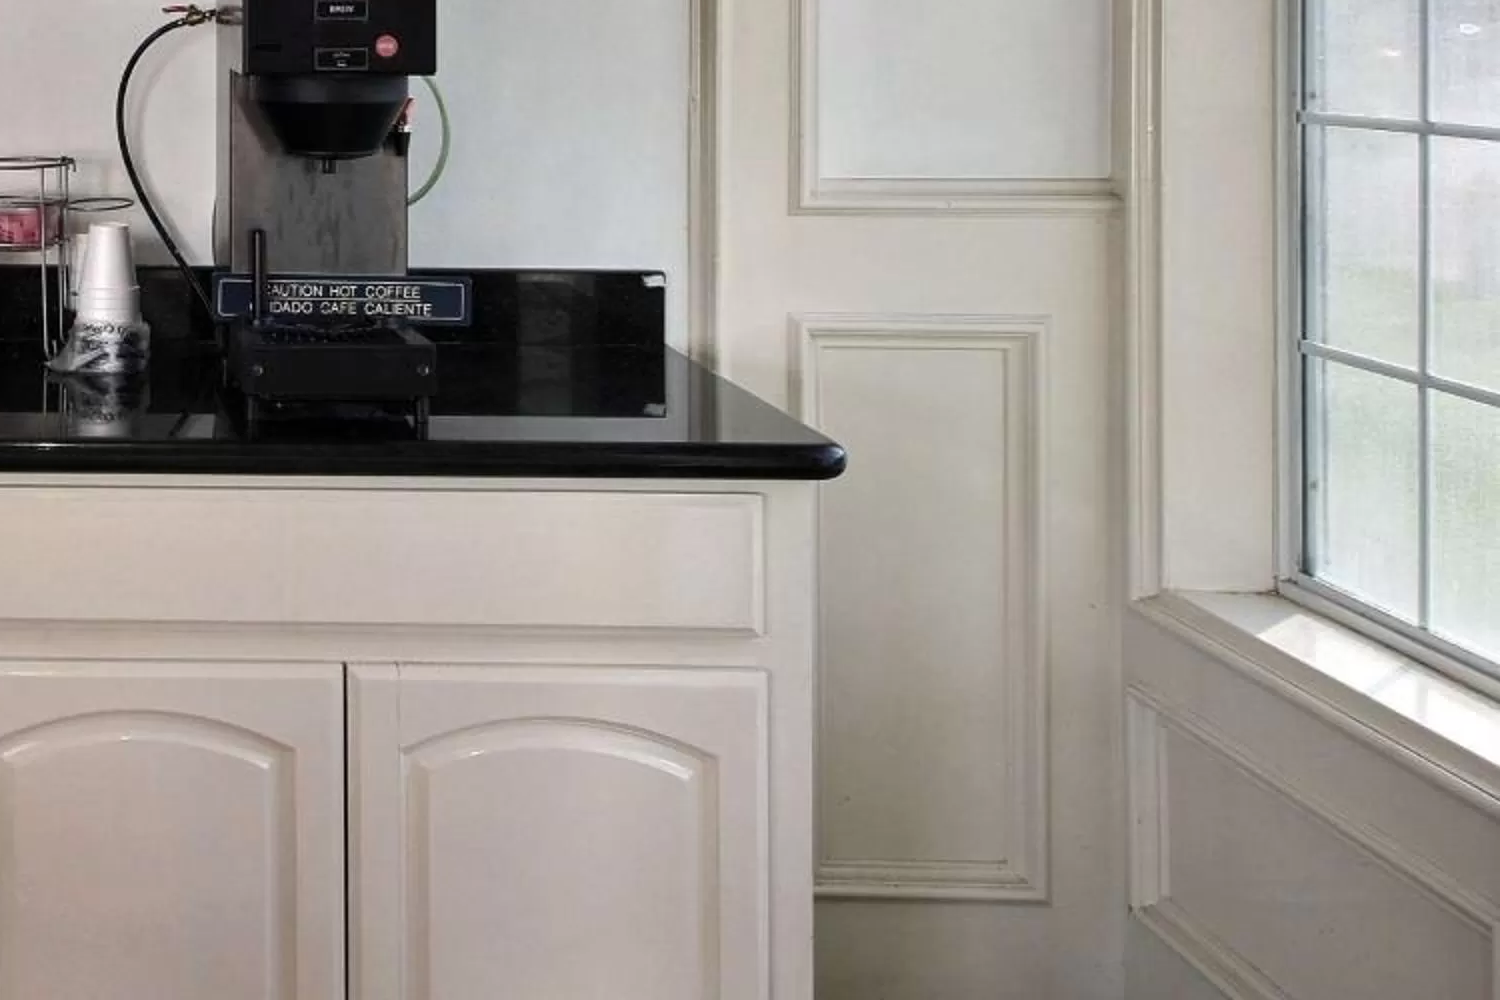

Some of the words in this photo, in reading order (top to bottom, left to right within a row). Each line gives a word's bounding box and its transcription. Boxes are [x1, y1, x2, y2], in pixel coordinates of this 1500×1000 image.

[329, 285, 357, 297] HOT
[365, 286, 421, 299] COFFEE
[320, 302, 357, 315] CAFE
[363, 302, 432, 317] CALIENTE
